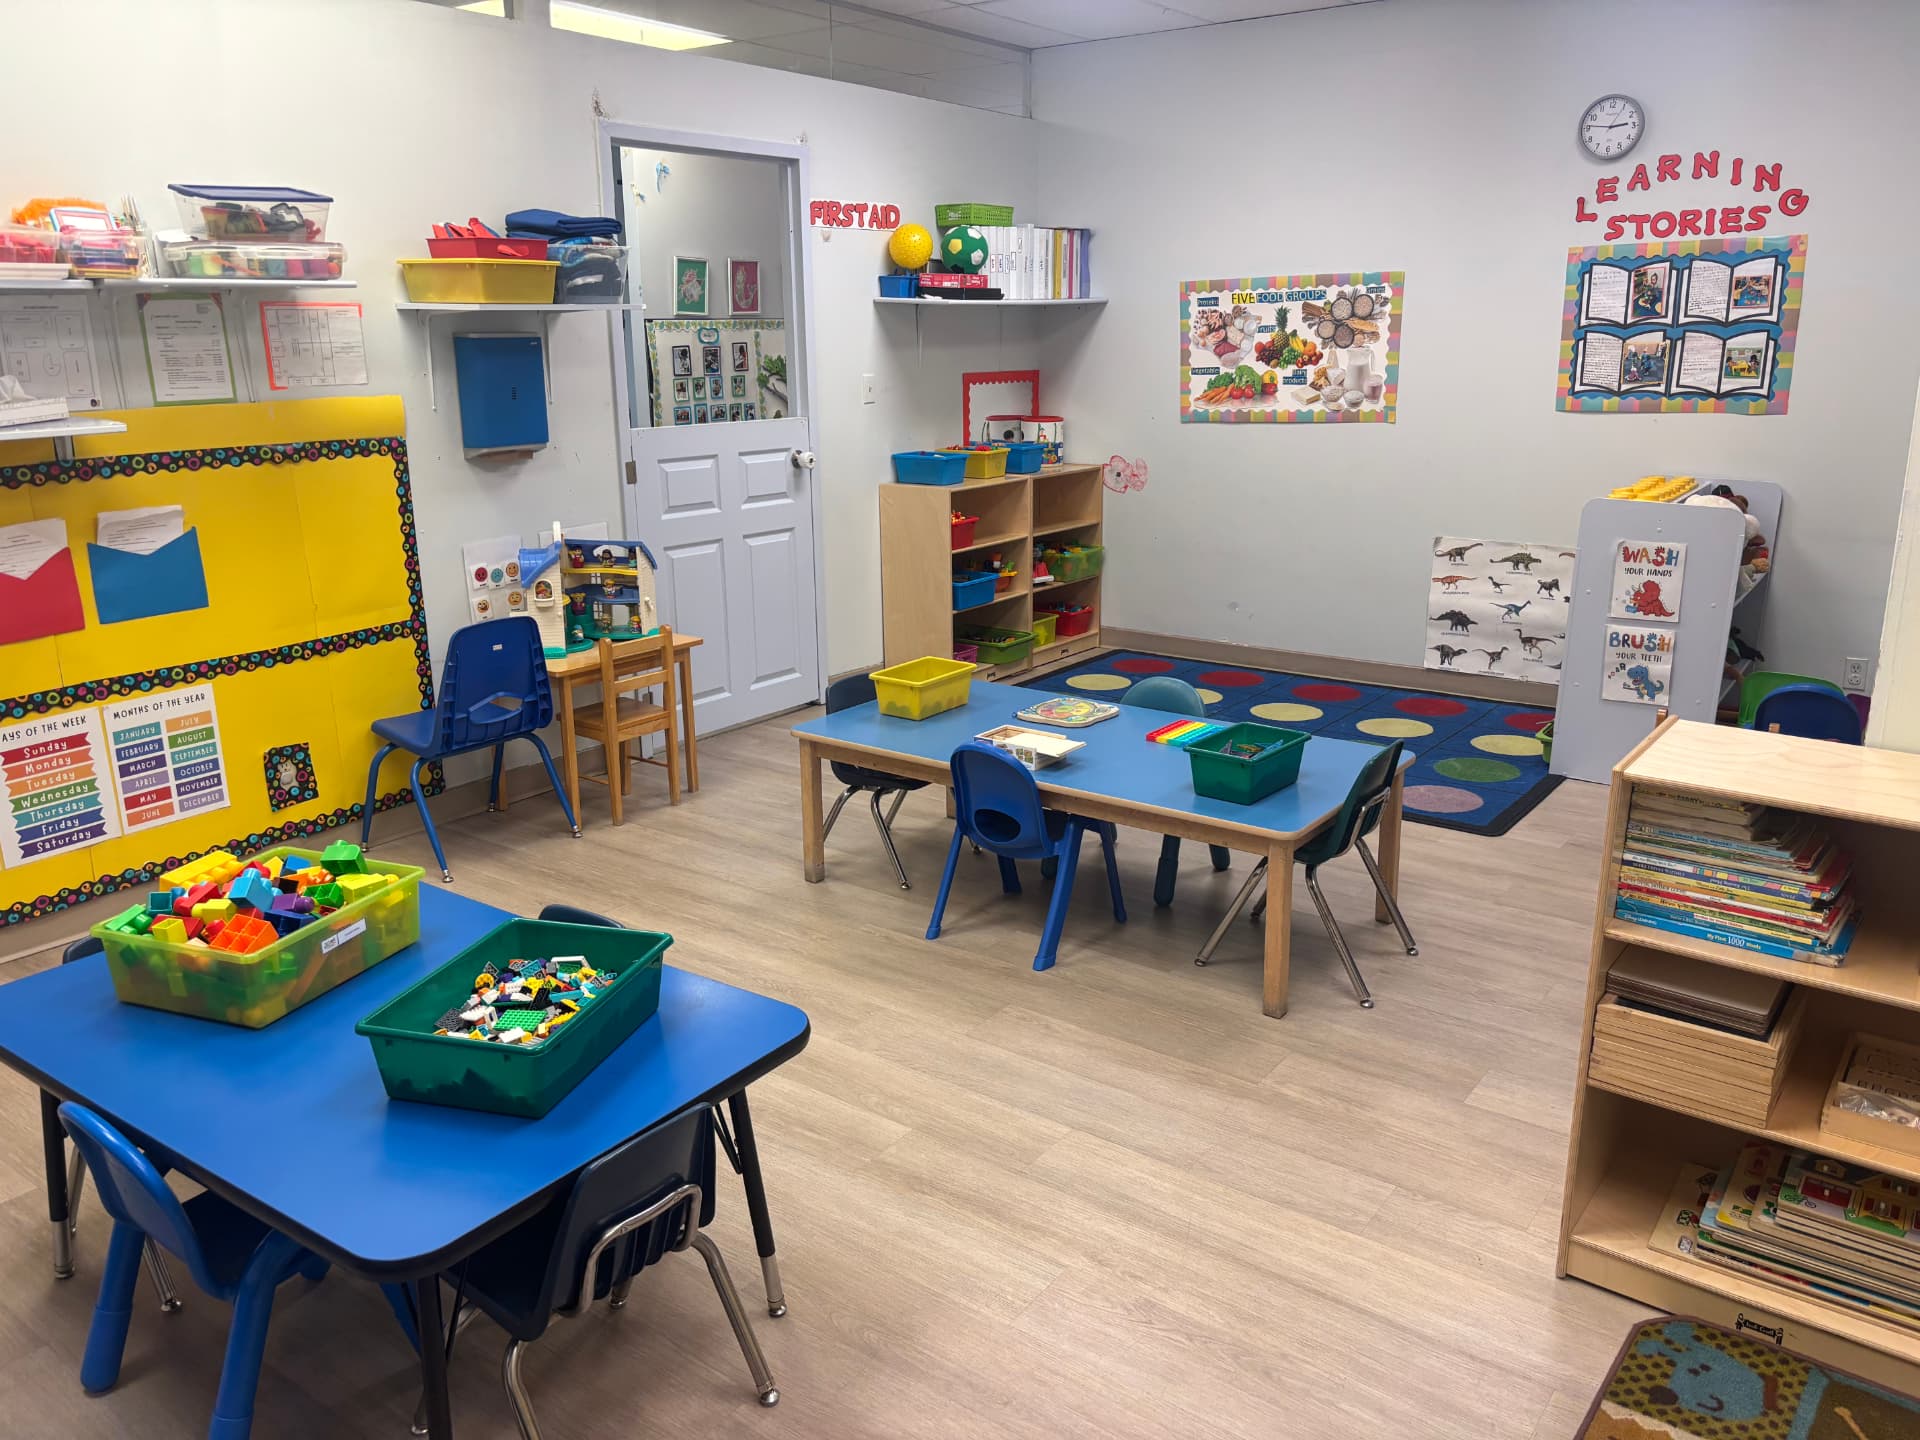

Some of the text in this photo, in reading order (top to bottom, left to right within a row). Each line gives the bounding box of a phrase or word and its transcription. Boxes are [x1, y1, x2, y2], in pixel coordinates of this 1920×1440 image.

[1576, 151, 1809, 222] LEARNING
[809, 201, 901, 230] FIRST AID
[1604, 205, 1771, 241] STORIES
[1231, 290, 1327, 304] FIVE FOOD GROUPS
[1622, 546, 1679, 567] WASH
[1624, 567, 1673, 577] YOUR HANDS
[1609, 631, 1671, 652] BRUSH
[1615, 652, 1662, 663] YOUR TEETH
[113, 692, 205, 720] MONTHS OF THE YEAR
[1, 715, 87, 743] AYS OF THE WEEK
[180, 717, 199, 726] JULY
[120, 726, 156, 740] JANUARY
[177, 731, 207, 745] AUGUST
[23, 741, 67, 758] Sunday
[121, 743, 159, 758] FEBRUARY
[175, 746, 214, 761] SEPTEMBER
[25, 757, 71, 775] Monday
[129, 760, 156, 772] MARCH
[180, 762, 213, 776] OCTOBER
[26, 771, 76, 791] Tuesday
[135, 776, 157, 788] APRIL
[180, 777, 218, 793] NOVEMBER
[21, 784, 89, 808] Wednesday
[139, 793, 157, 804] MAY
[183, 793, 219, 809] DECEMBER
[29, 801, 85, 822] Thursday
[141, 808, 160, 820] JUNE
[41, 818, 80, 836] Friday
[36, 830, 92, 853] Saturday
[1727, 936, 1745, 947] 1000
